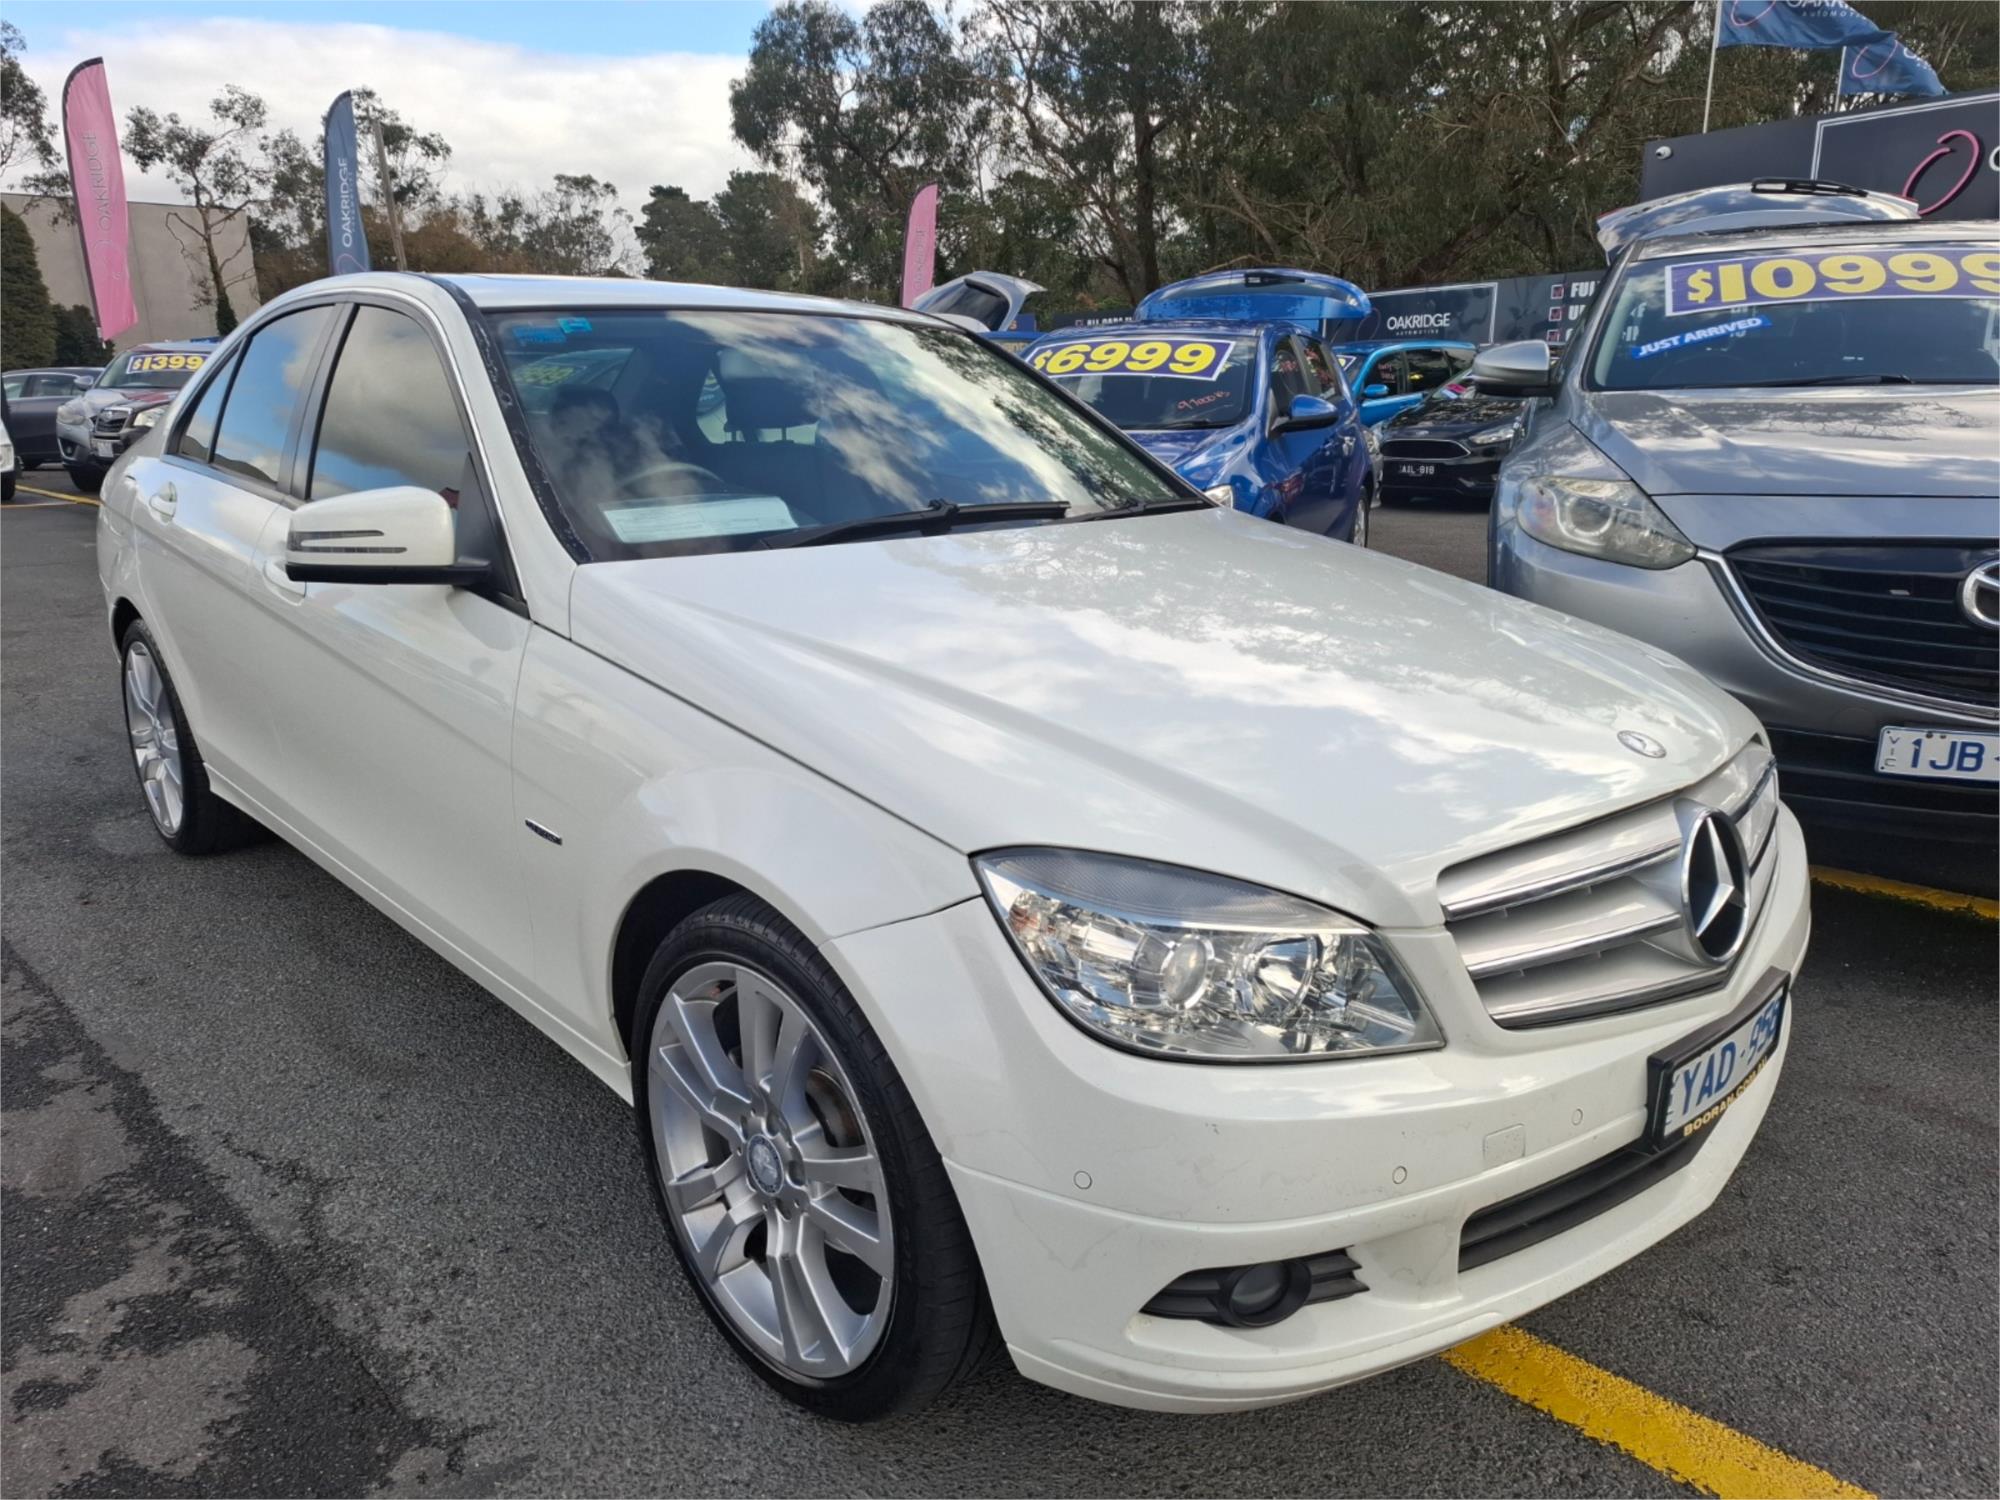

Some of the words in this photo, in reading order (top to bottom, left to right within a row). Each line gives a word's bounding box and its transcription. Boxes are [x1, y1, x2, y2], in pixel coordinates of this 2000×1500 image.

[82, 132, 112, 232] OAKRIDGE
[338, 158, 352, 248] OAKRIDGE
[1387, 313, 1451, 330] OAKRIDGE
[1639, 335, 1681, 356] JUST
[1684, 318, 1762, 342] ARRIVED
[1034, 342, 1216, 374] $6999
